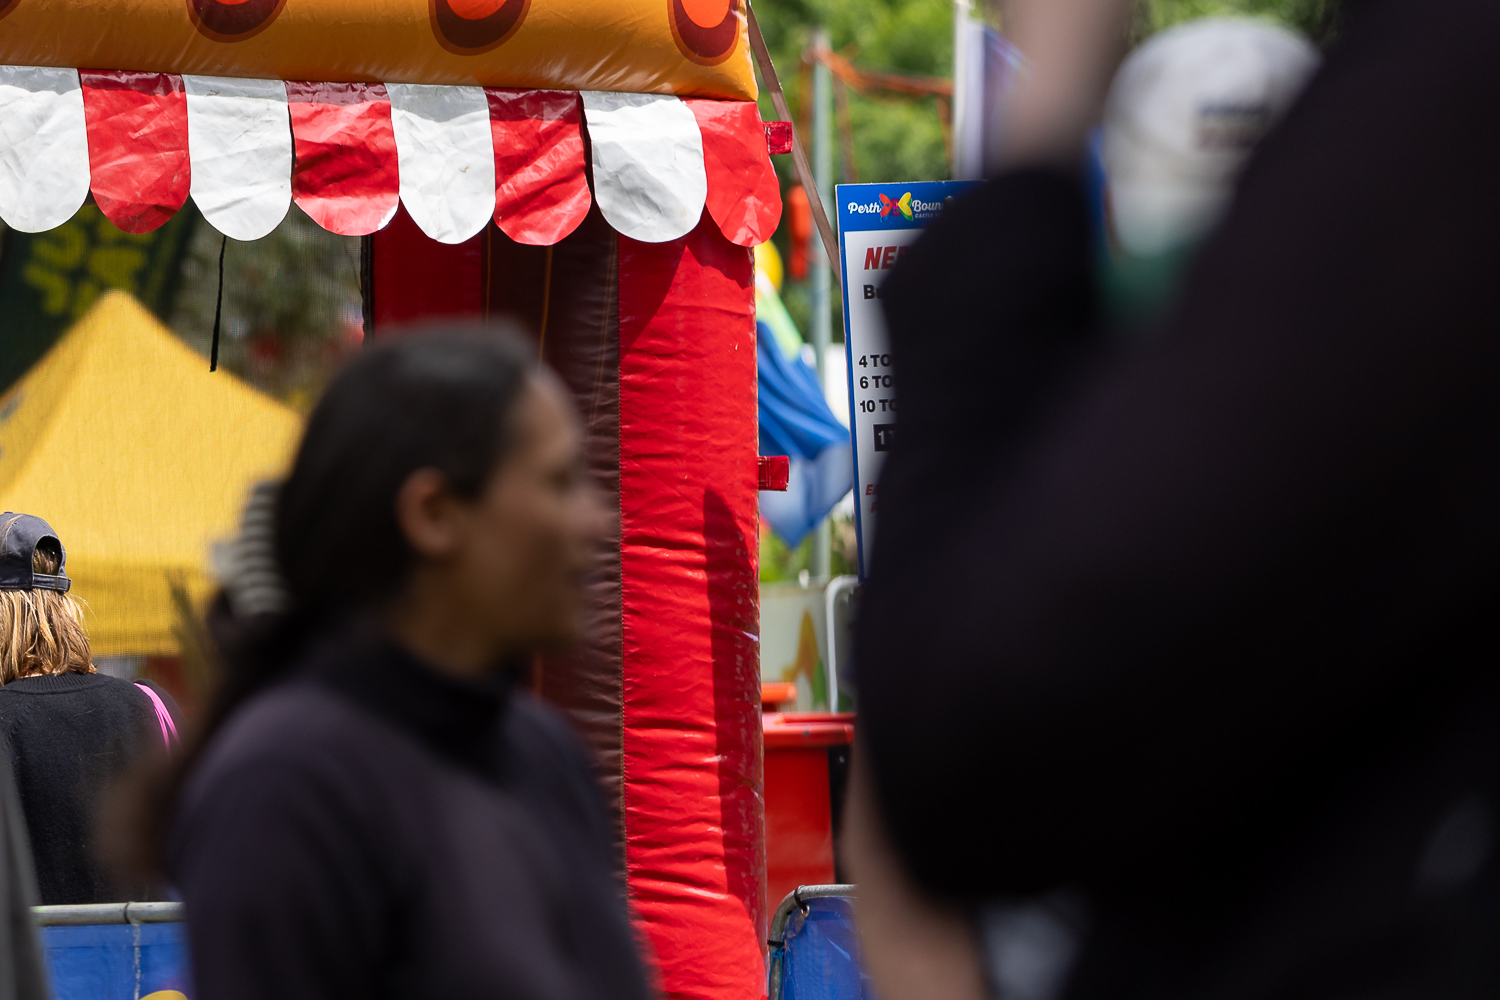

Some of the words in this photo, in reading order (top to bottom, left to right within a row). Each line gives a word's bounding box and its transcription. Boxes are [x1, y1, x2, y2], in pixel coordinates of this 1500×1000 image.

[847, 202, 881, 214] Perth
[911, 199, 944, 212] Boun
[858, 355, 868, 368] 4
[860, 376, 869, 389] 6
[860, 399, 876, 413] 10
